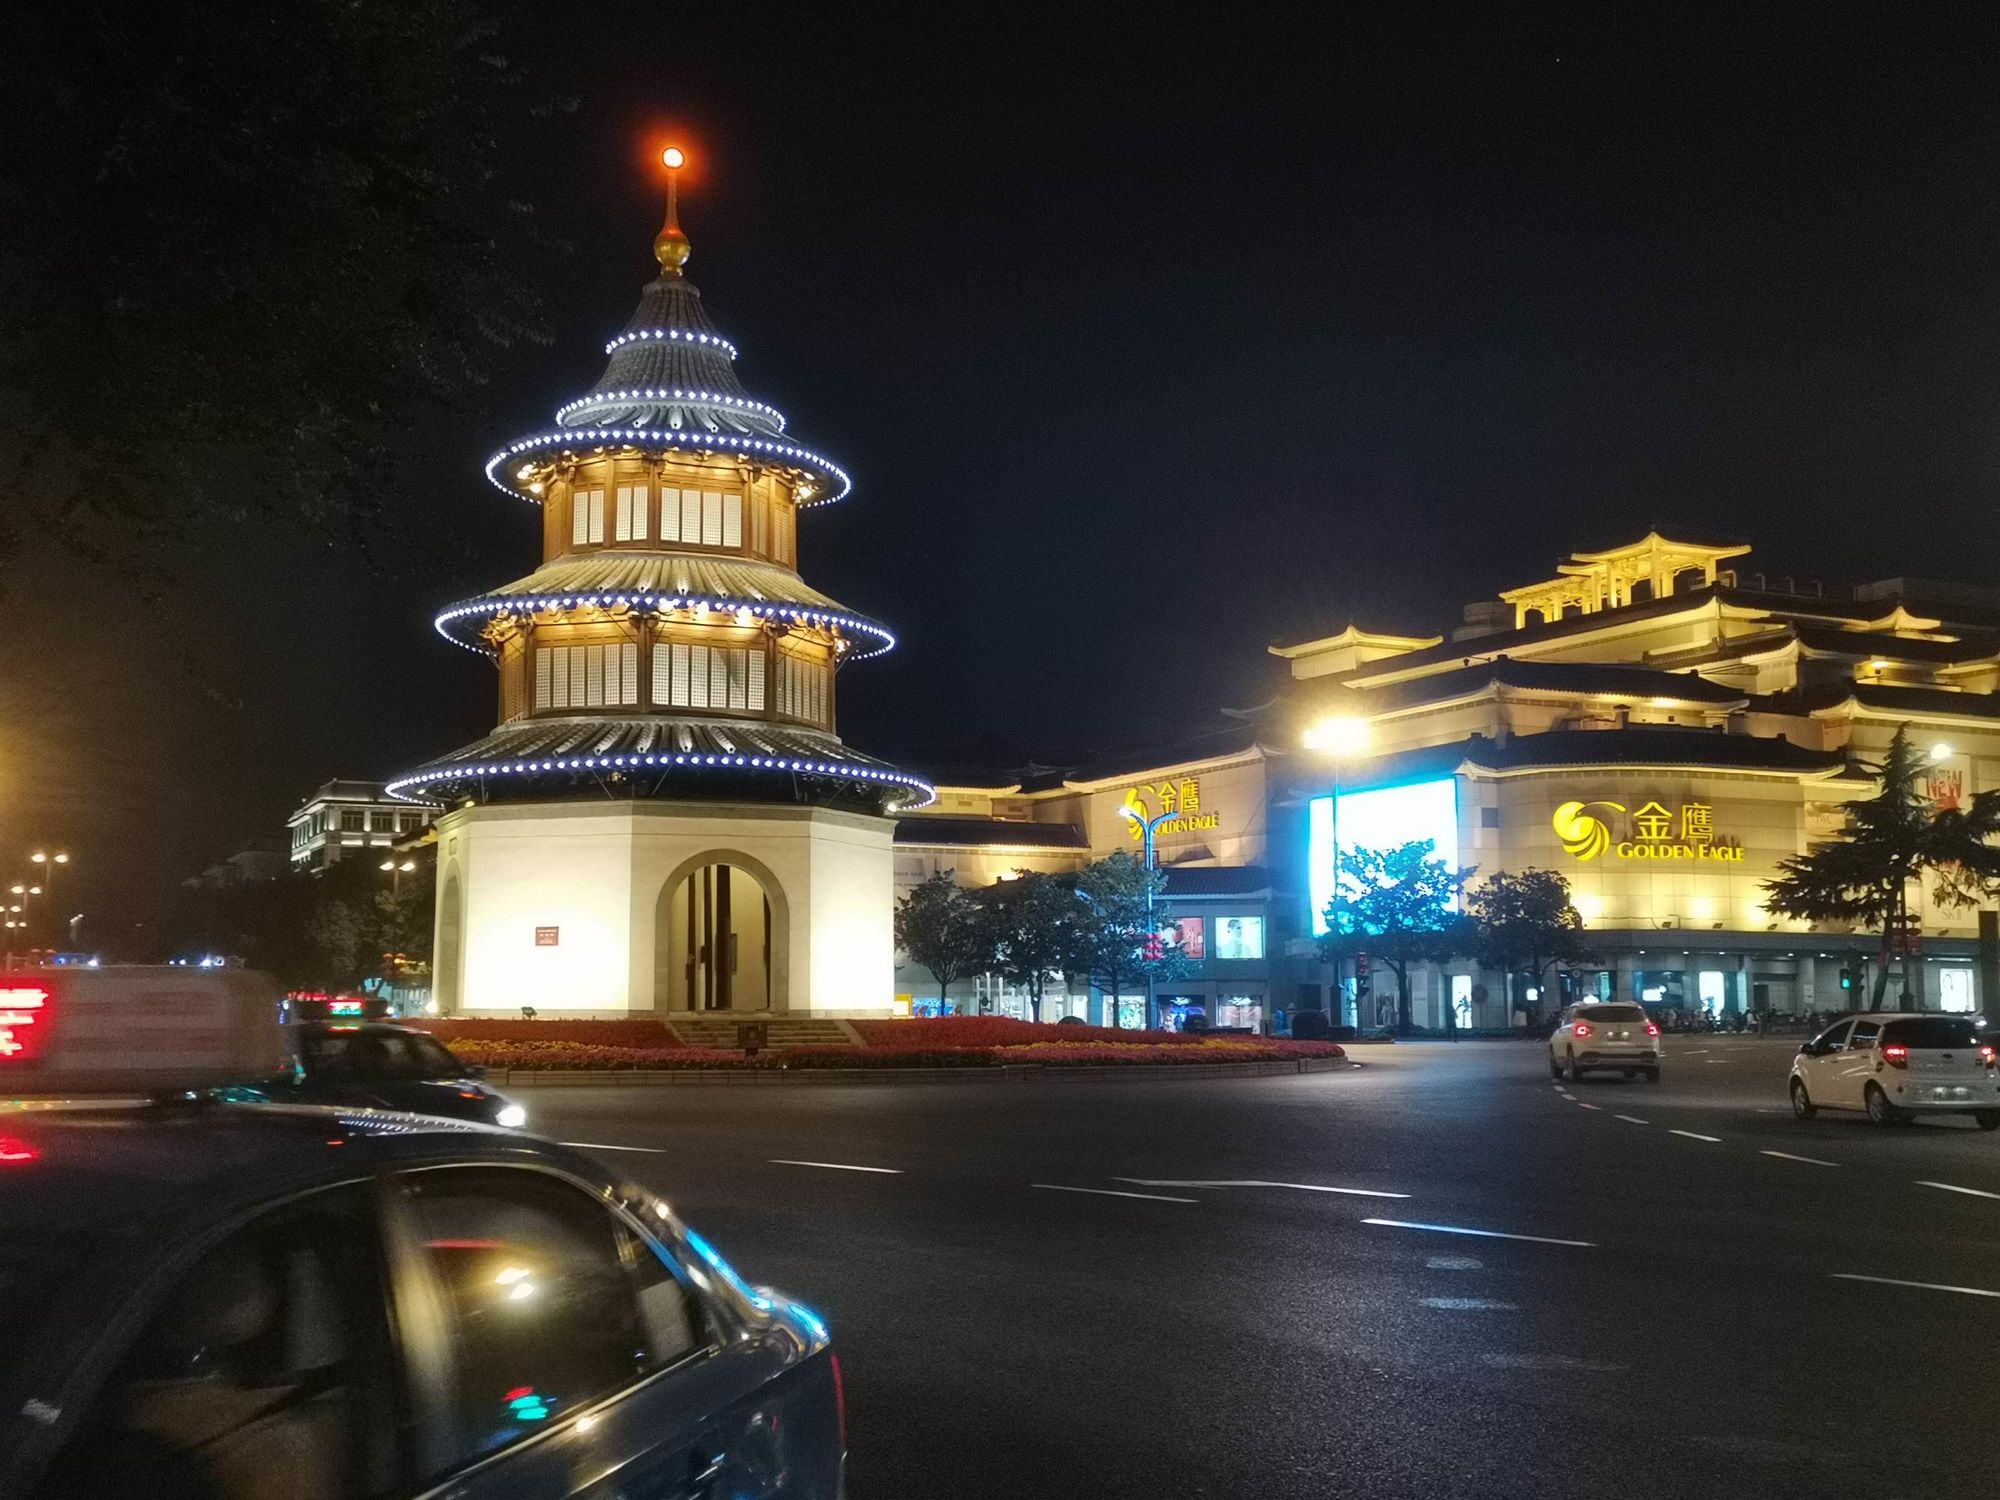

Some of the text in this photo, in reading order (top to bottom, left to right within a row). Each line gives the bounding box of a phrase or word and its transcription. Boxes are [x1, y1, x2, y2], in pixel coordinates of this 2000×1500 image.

[1158, 777, 1200, 814] 金鹰
[1926, 770, 1962, 799] NEW
[1155, 815, 1217, 835] OLDEN EAGLE
[1633, 801, 1713, 843] 金鹰
[1616, 842, 1745, 862] GOLDEN EAGLE
